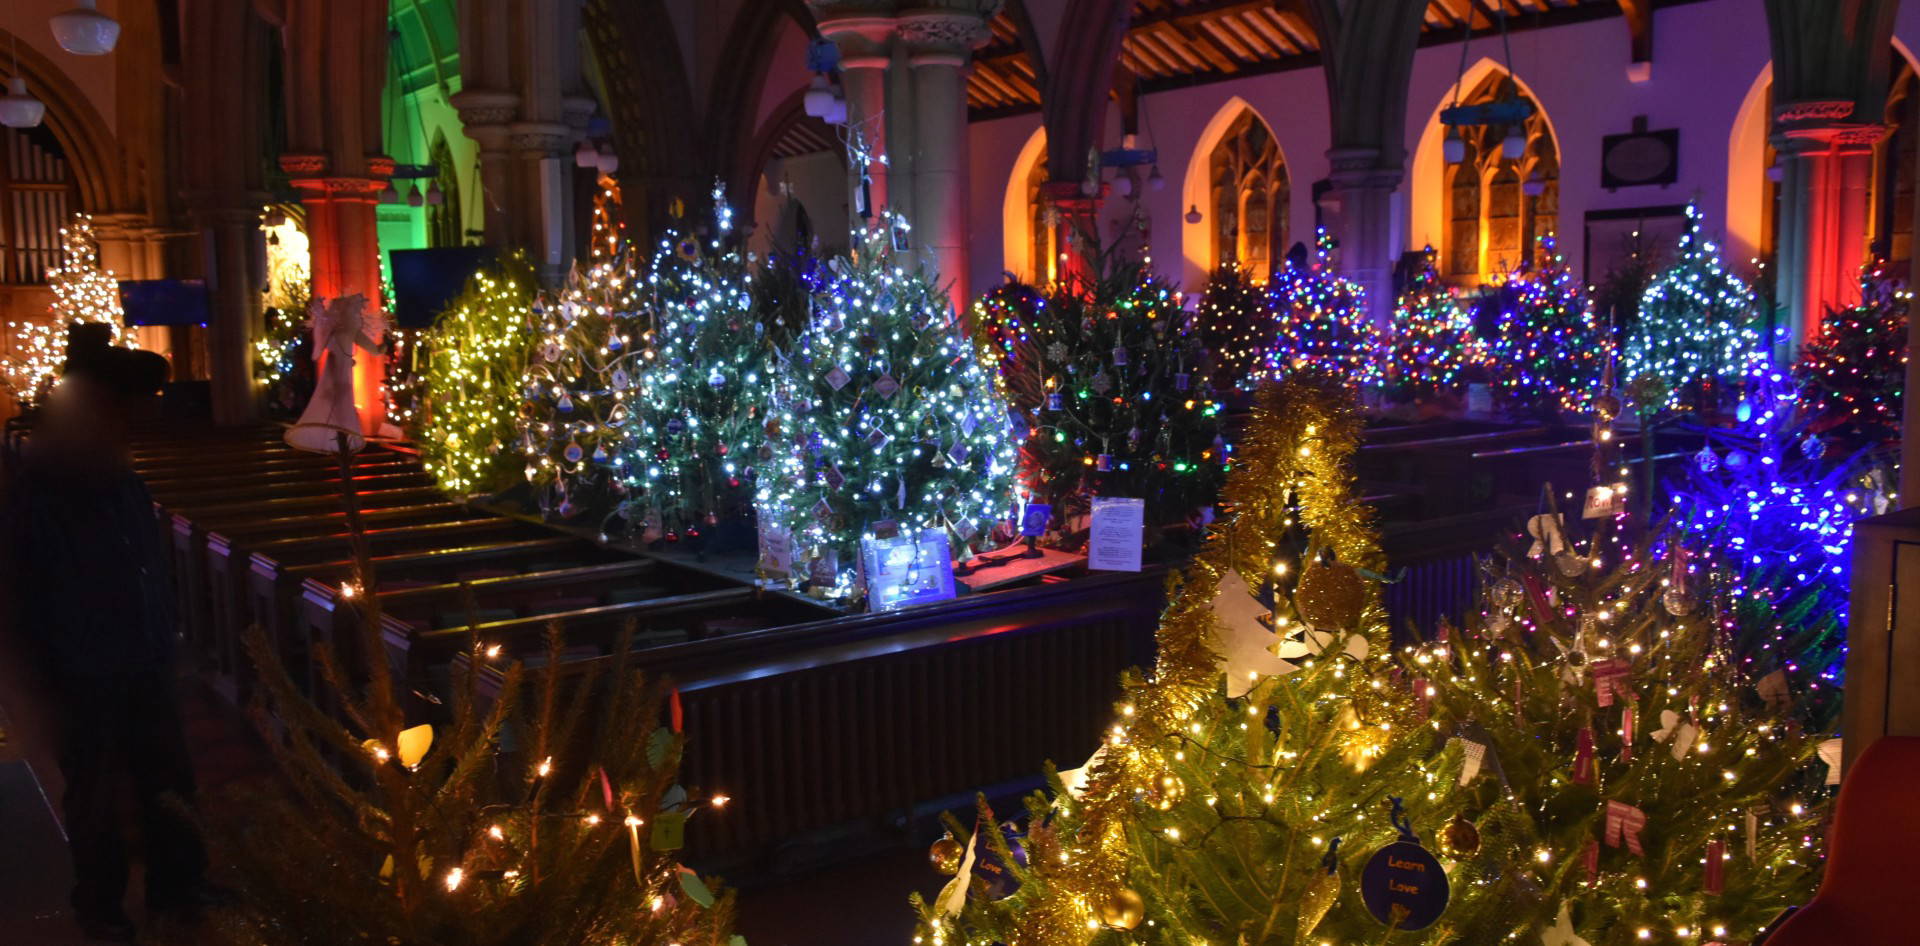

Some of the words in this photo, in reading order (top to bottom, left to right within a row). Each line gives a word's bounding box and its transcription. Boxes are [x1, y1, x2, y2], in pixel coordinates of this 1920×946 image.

[980, 858, 1002, 874] Love
[1388, 856, 1425, 872] Learn
[1389, 880, 1420, 894] Love
